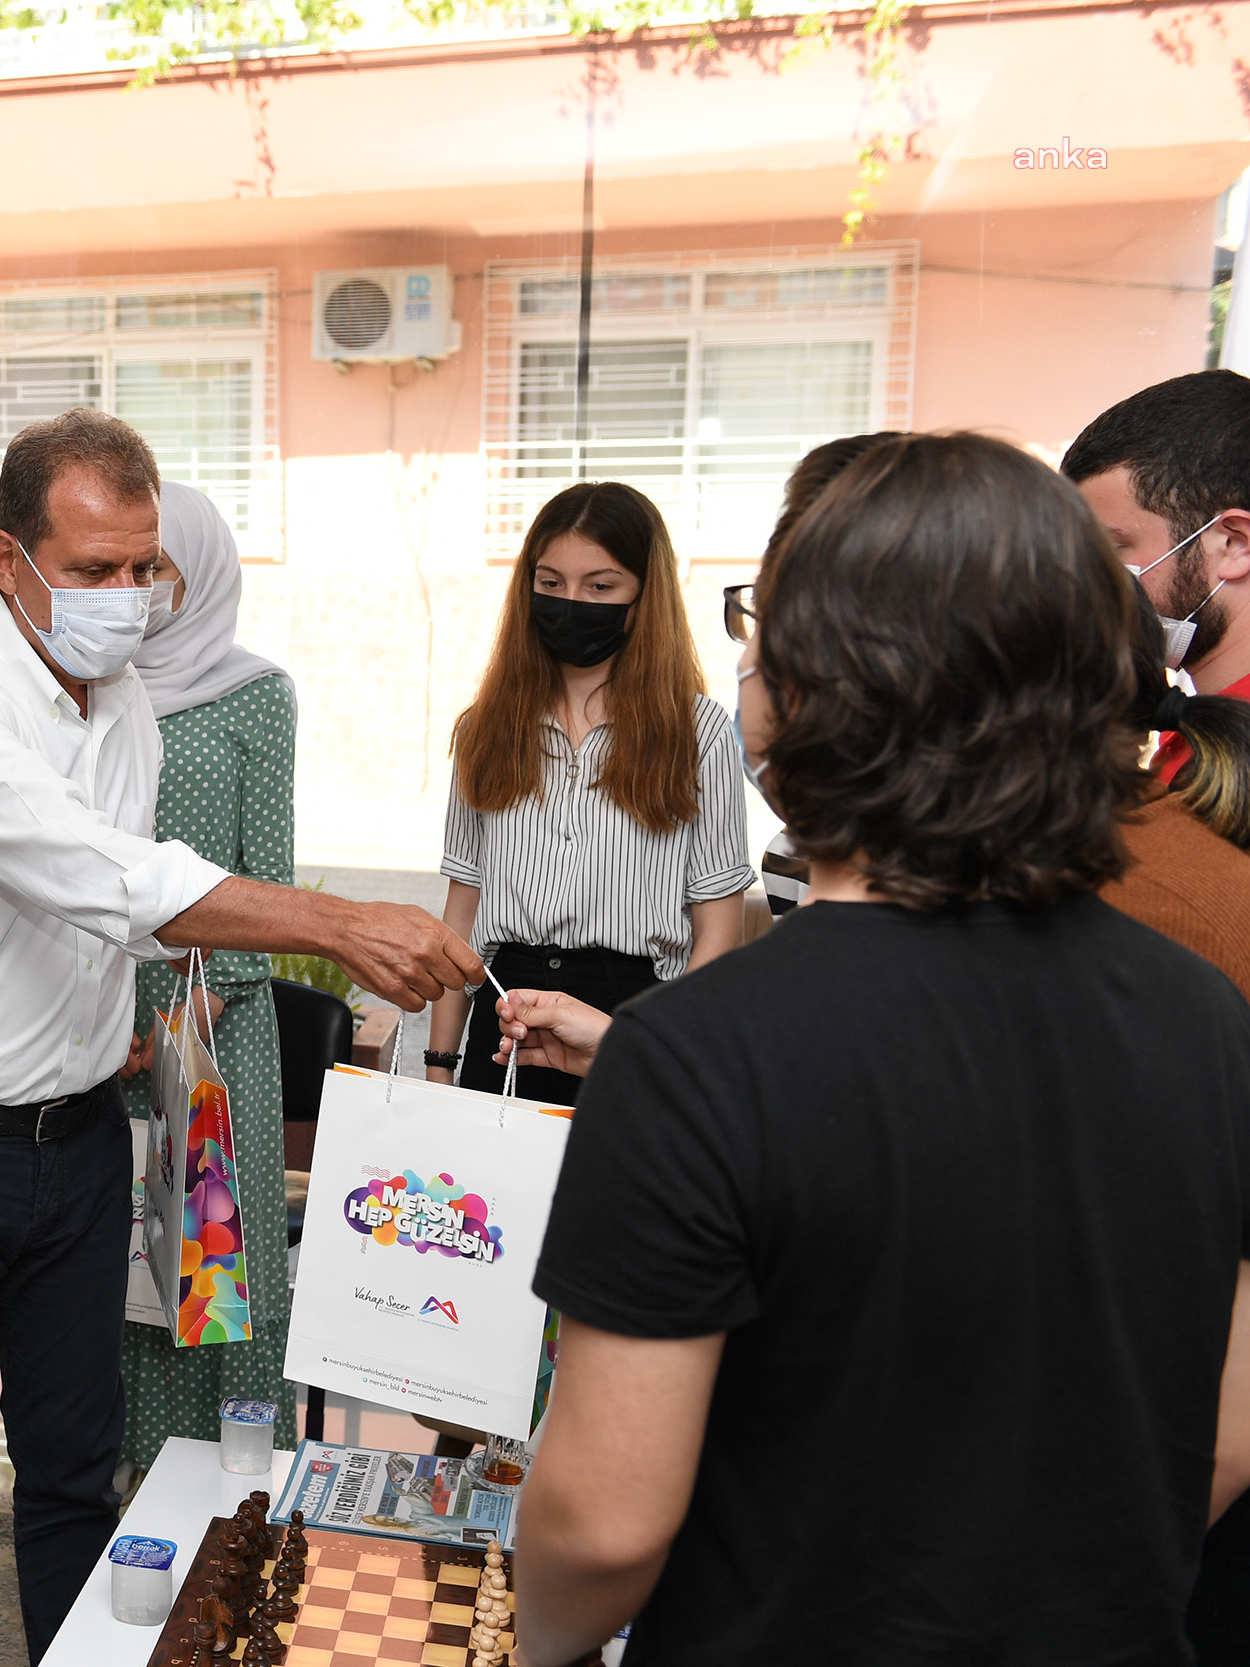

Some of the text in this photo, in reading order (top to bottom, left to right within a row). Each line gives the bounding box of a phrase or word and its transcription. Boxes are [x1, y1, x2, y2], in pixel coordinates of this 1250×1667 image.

[213, 1092, 228, 1176] www.mersin.bel.tr
[381, 1185, 465, 1230] MERSİN
[348, 1199, 495, 1263] HEP GÜZELSİN
[354, 1286, 384, 1309] Vahap
[368, 1379, 400, 1391] mersin_bld
[345, 1452, 371, 1470] GİBİ
[333, 1470, 366, 1511] VERDİĞİMİZ
[325, 1511, 352, 1523] SÖZ
[131, 1543, 160, 1551] berrak
